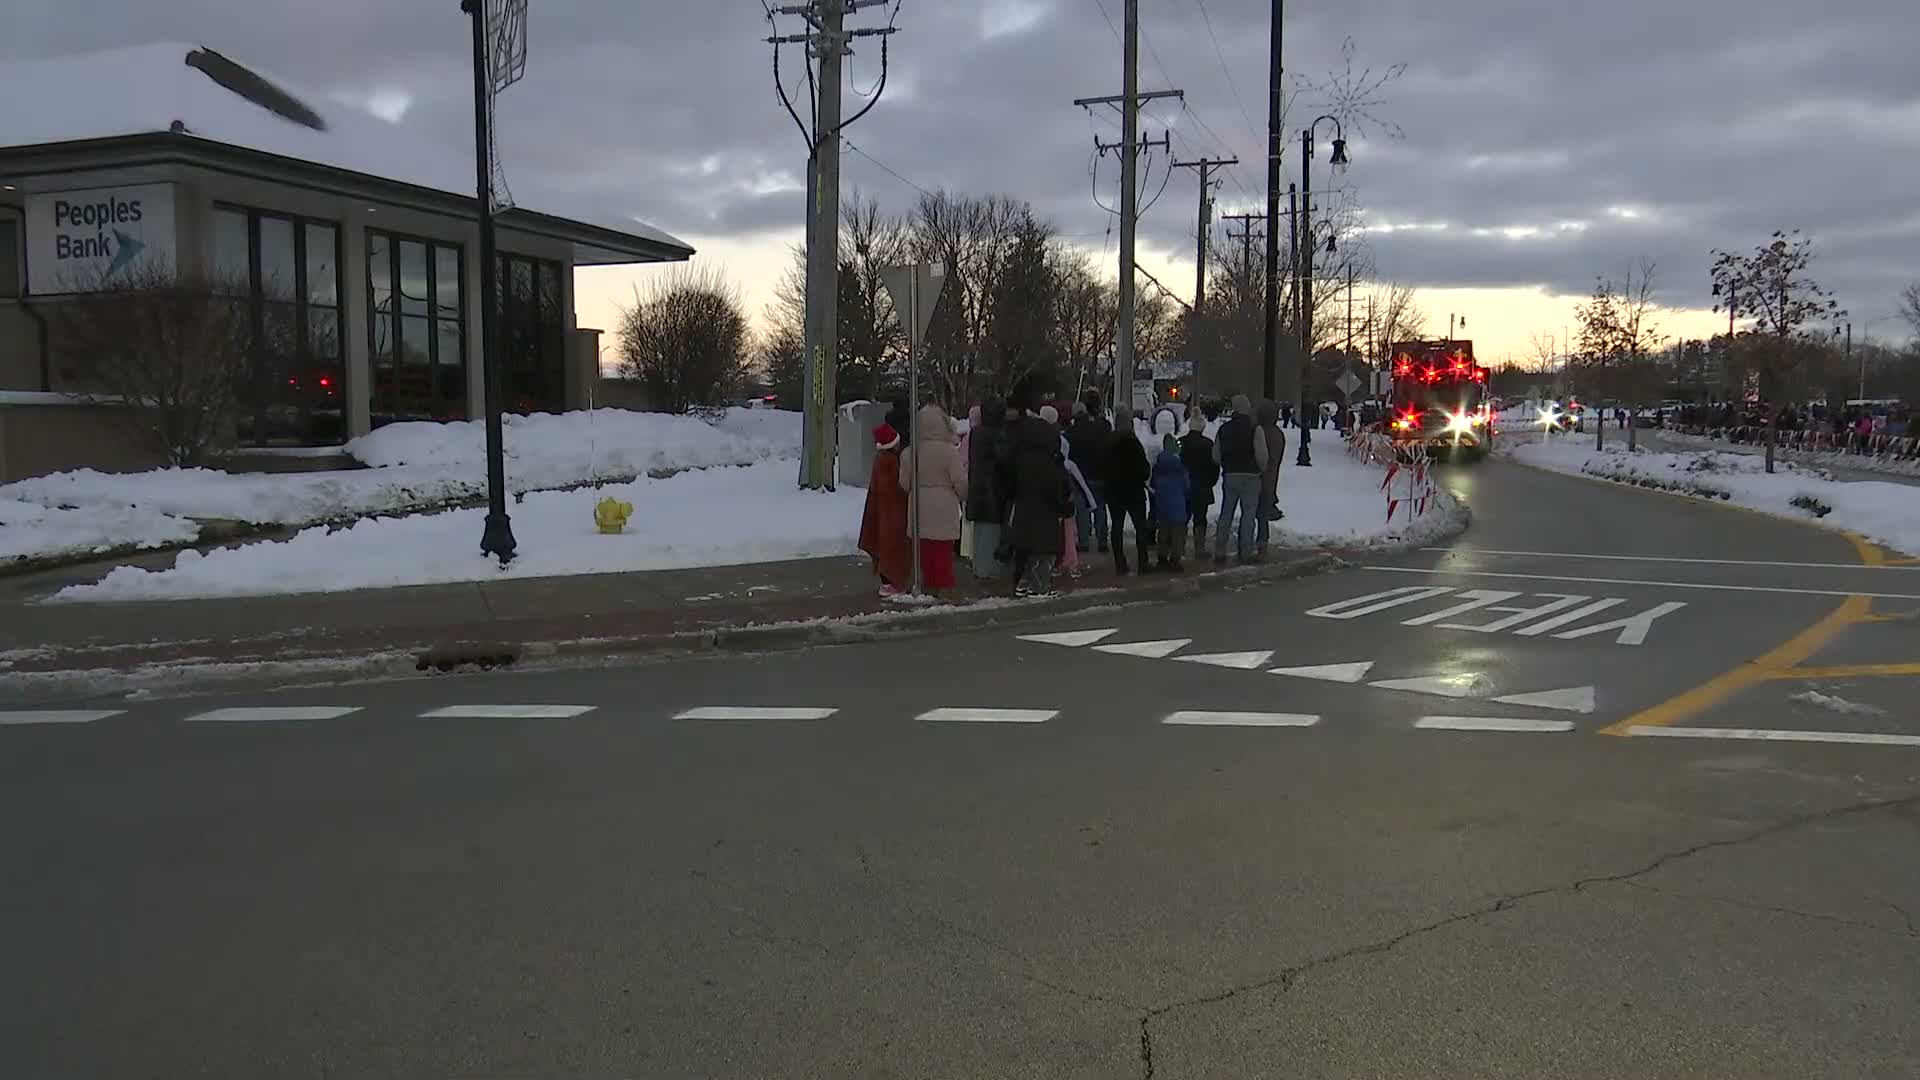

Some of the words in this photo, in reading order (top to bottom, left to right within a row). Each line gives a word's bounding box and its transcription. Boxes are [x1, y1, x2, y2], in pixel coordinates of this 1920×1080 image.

[55, 196, 142, 230] Peoples
[56, 233, 111, 260] Bank
[1304, 586, 1688, 645] YIELD
